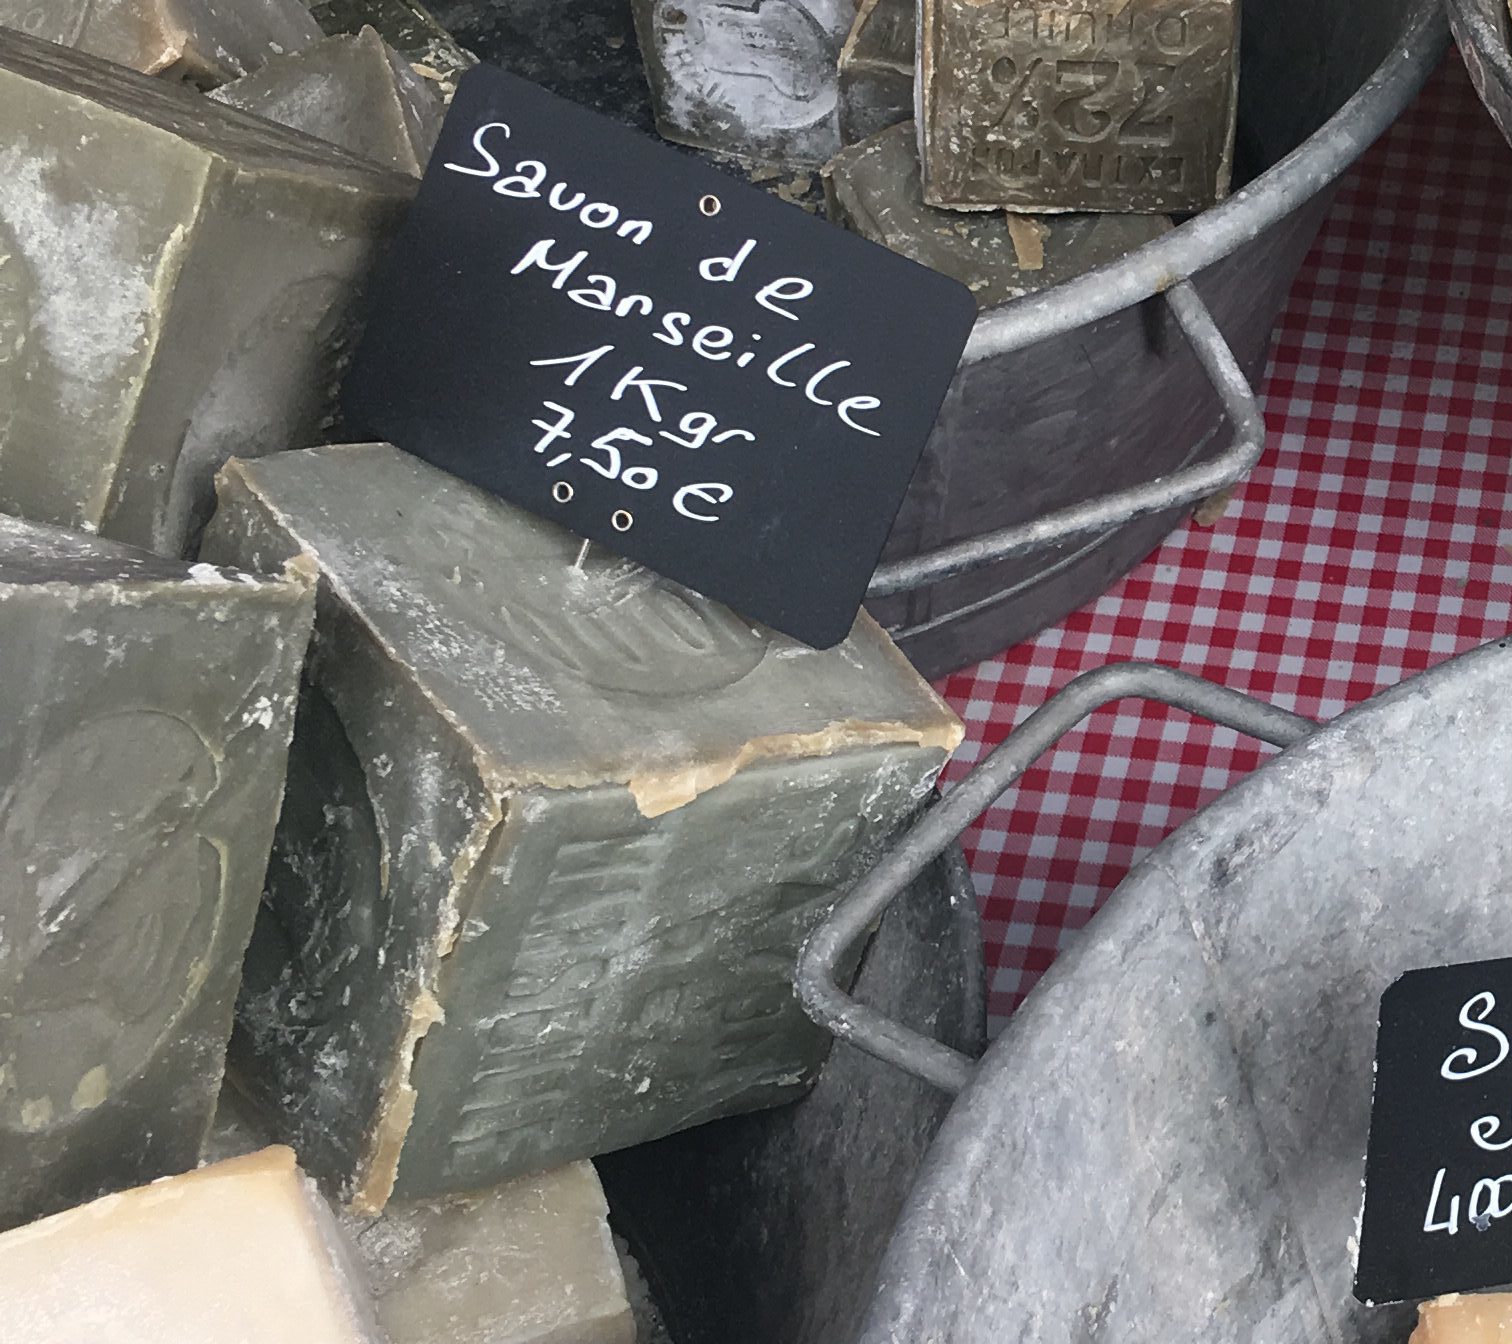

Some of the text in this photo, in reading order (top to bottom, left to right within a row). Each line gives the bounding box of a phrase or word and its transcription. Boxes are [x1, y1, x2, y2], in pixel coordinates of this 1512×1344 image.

[444, 122, 814, 321] Savon de
[510, 239, 882, 436] Marseille
